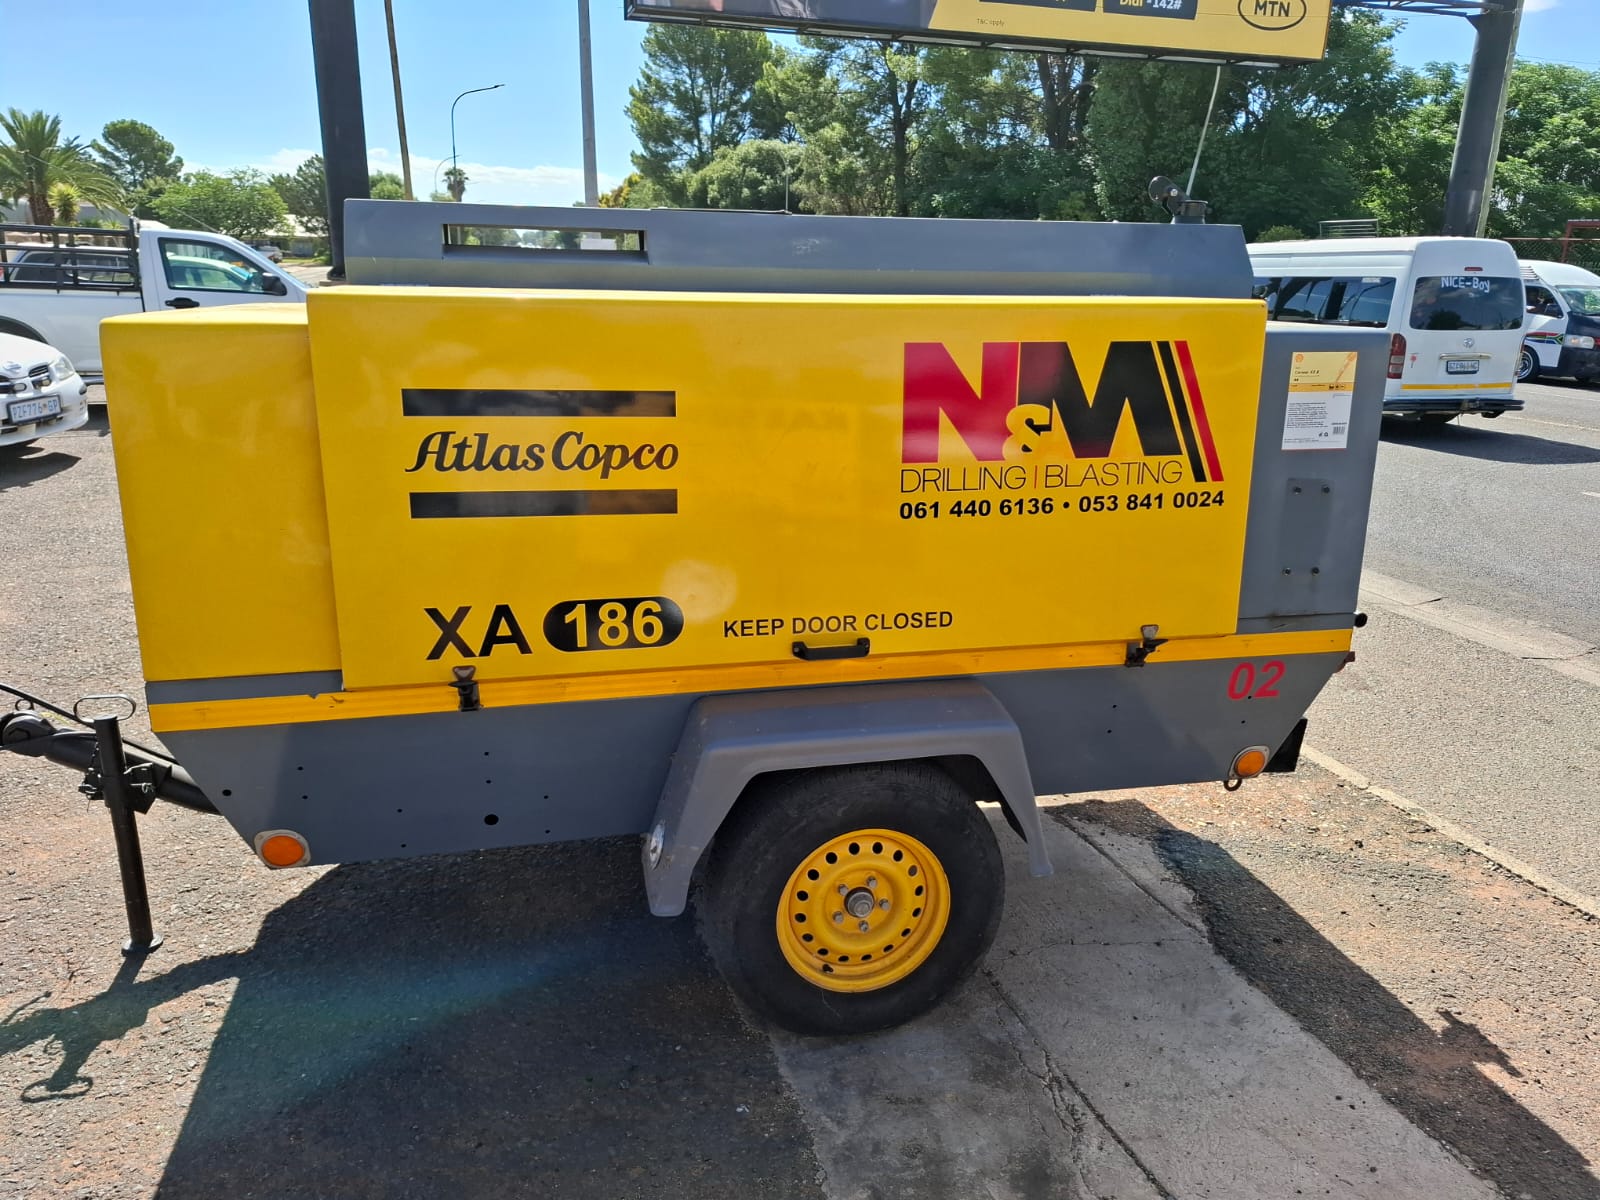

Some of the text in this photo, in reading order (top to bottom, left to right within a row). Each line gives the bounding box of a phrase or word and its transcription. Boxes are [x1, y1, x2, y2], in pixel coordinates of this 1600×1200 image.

[1254, 1, 1290, 17] MTN
[1441, 276, 1490, 293] NICE-Boy
[902, 340, 1184, 464] N&M
[404, 431, 679, 480] Atlas Copco
[900, 460, 1183, 493] DRILLING BLASTING
[899, 490, 1225, 520] 061 440 6136 053 841 0024
[423, 600, 664, 661] XA 186
[723, 611, 953, 638] KEEP DOOR CLOSED
[1227, 660, 1287, 700] 02
